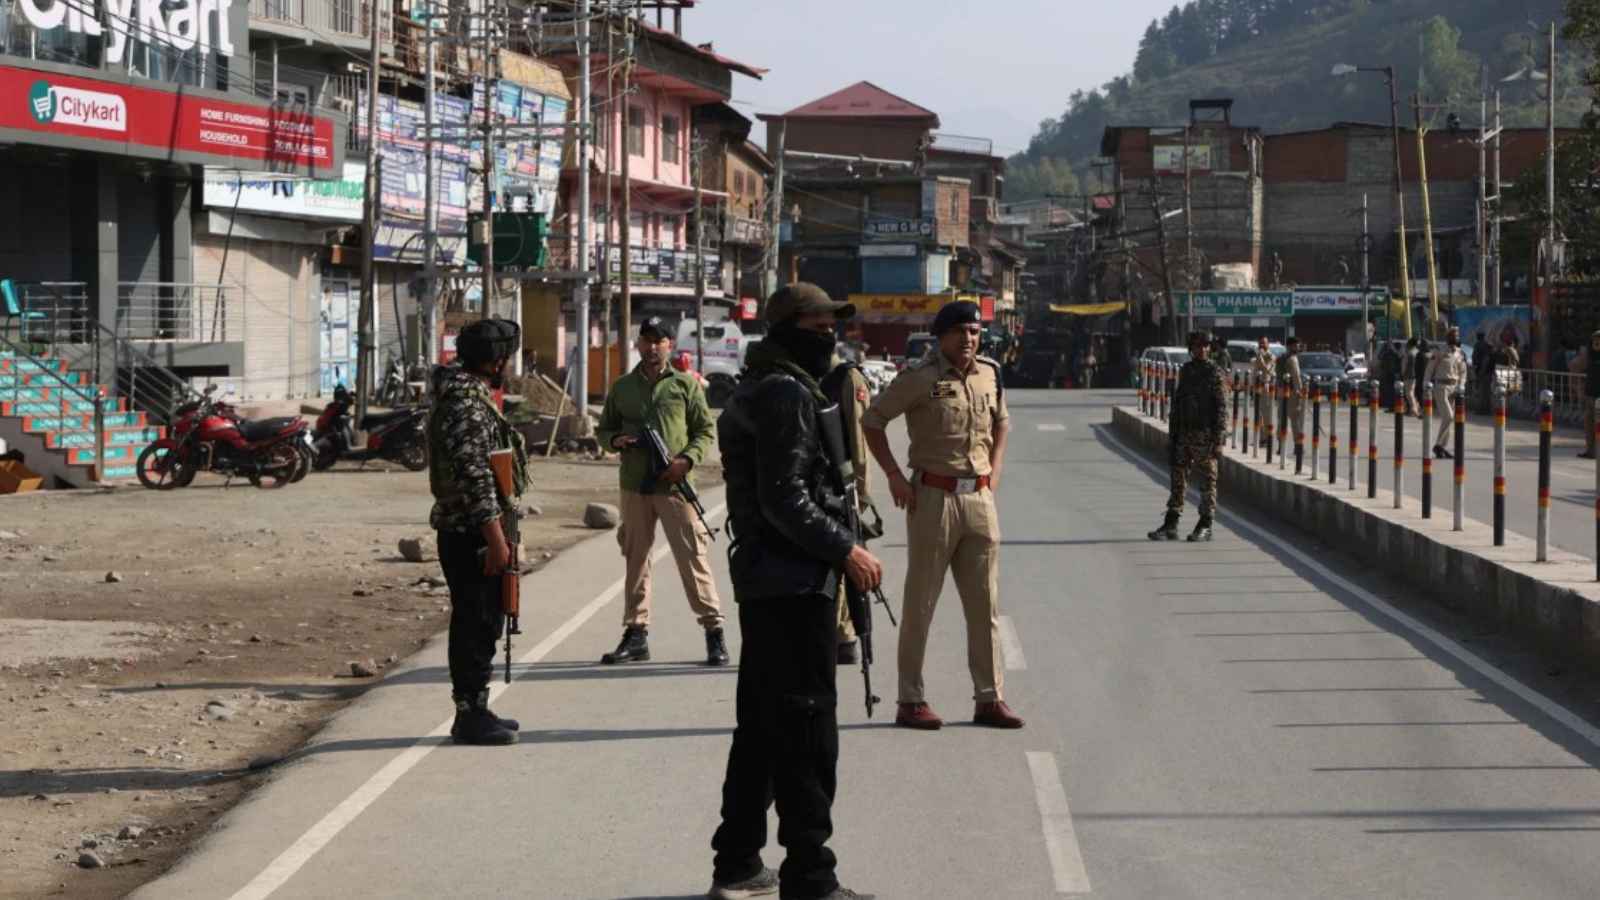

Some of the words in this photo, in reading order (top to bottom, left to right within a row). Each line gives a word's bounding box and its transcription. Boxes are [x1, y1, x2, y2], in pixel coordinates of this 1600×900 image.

[60, 96, 121, 127] Citykart
[200, 108, 224, 121] HOME
[200, 129, 248, 145] HOUSEHOLD
[1217, 295, 1289, 307] PHARMACY
